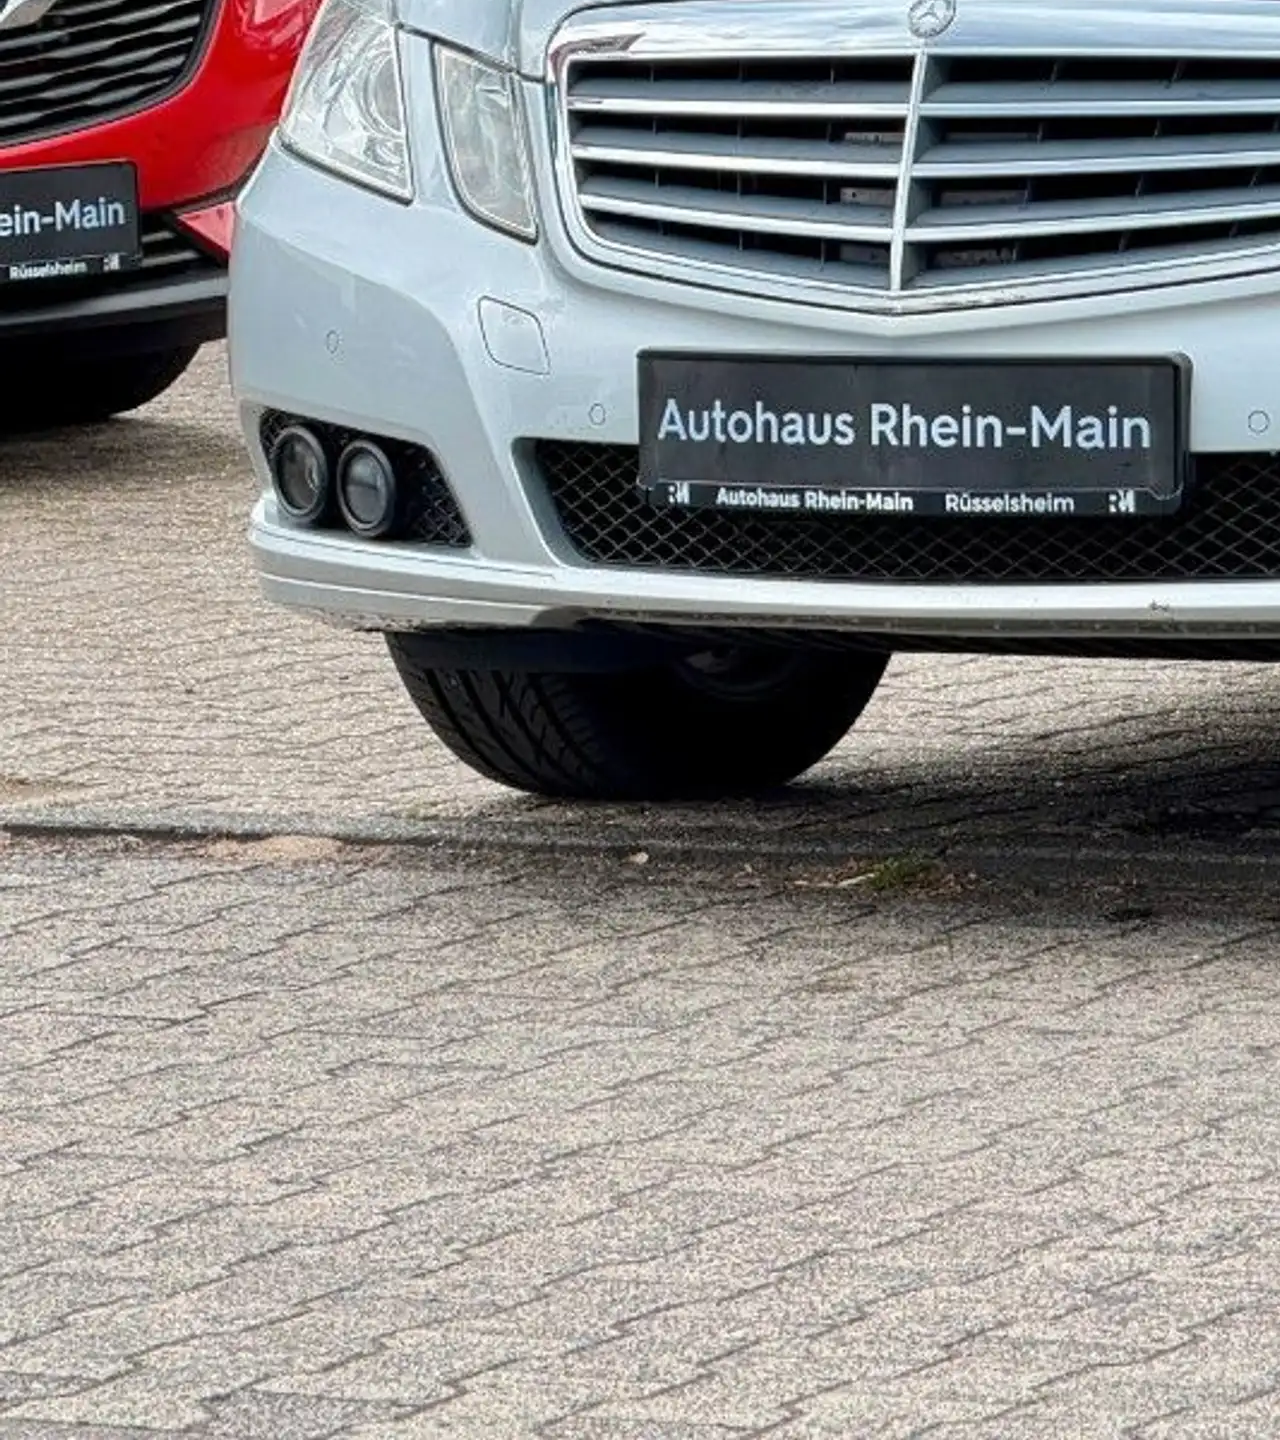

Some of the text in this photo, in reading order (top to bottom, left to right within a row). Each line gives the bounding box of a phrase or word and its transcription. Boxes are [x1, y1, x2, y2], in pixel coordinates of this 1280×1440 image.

[657, 398, 1151, 449] Autohaus Rhein-Main
[715, 486, 801, 509] Autohaus
[803, 490, 914, 512] Rhein-Main
[944, 492, 1075, 514] Rüsselsheim
